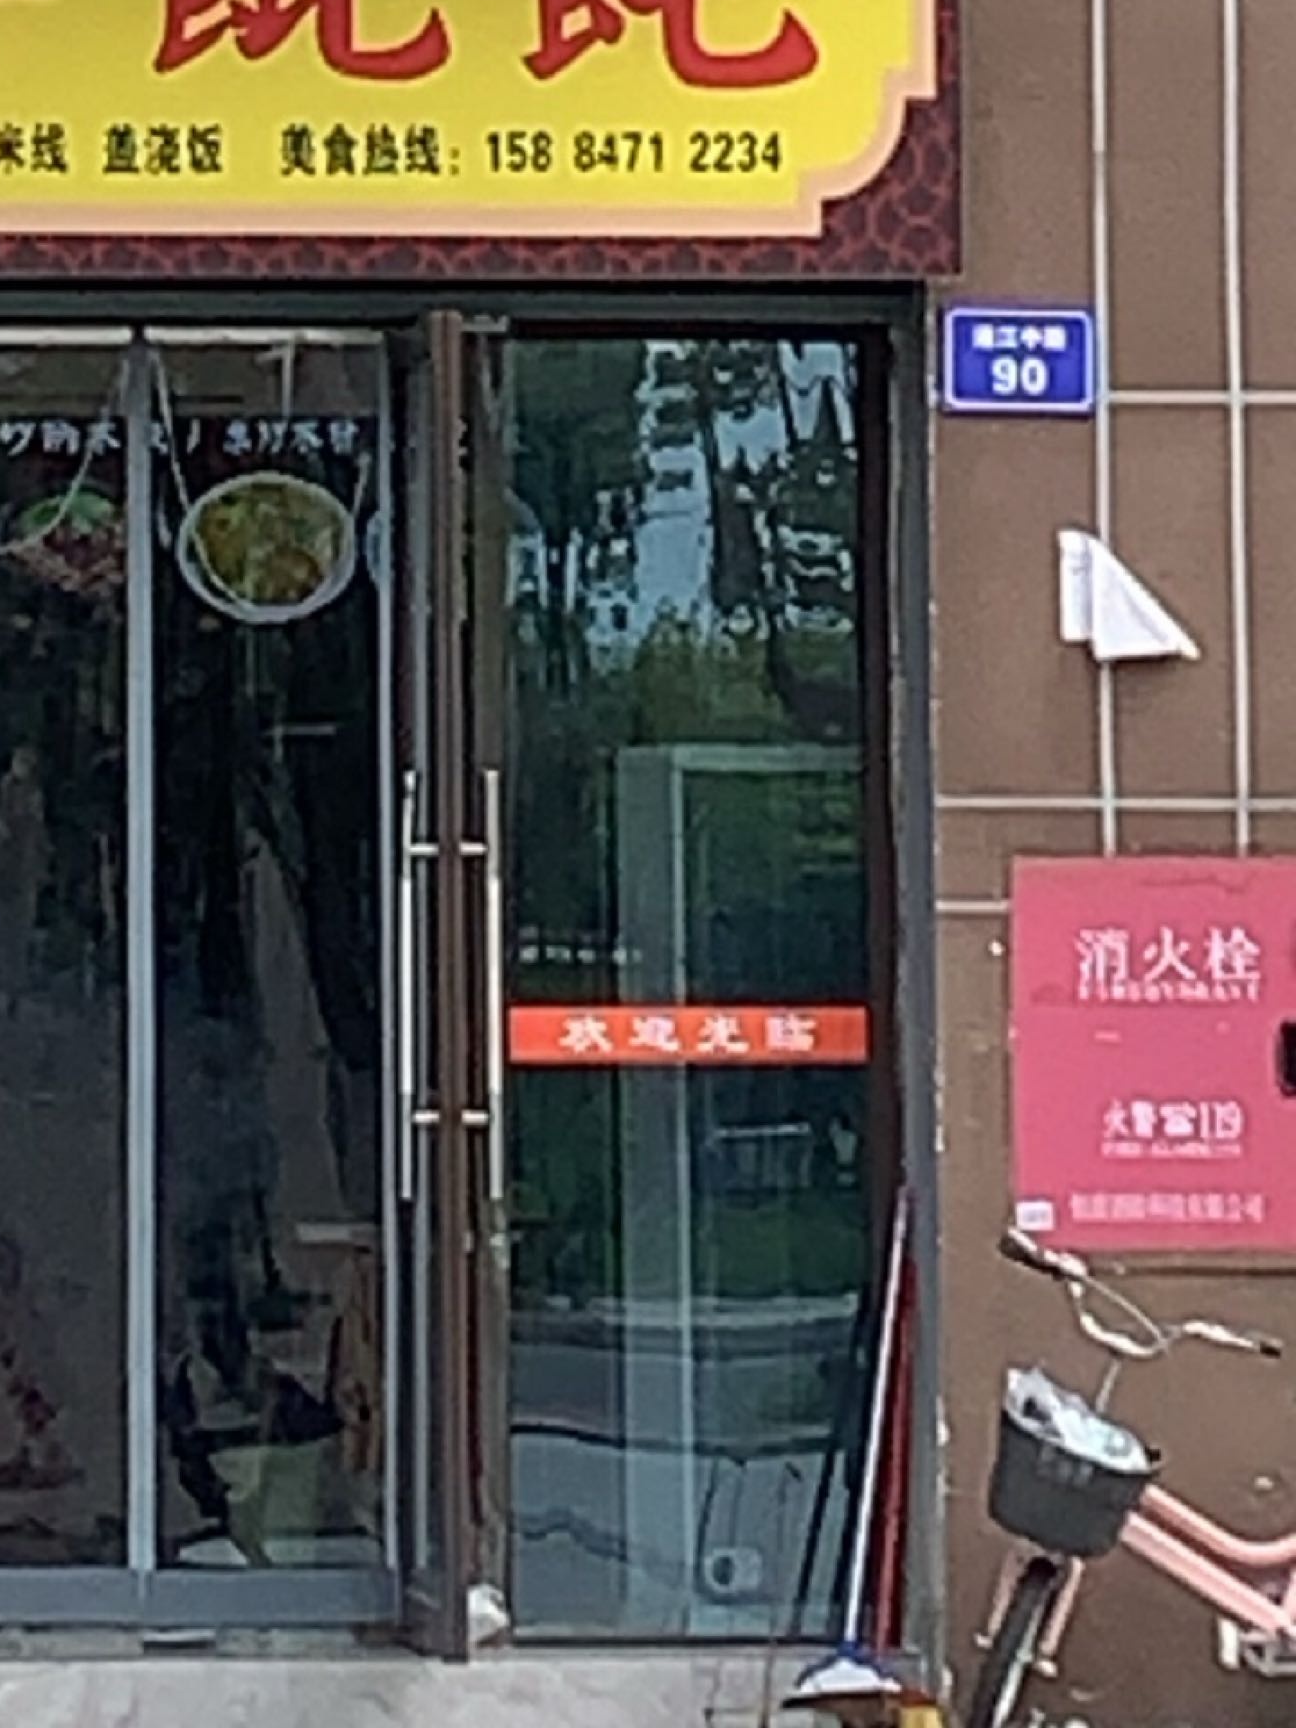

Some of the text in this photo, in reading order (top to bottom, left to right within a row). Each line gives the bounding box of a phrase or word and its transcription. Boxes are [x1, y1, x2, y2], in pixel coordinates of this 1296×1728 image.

[102, 123, 224, 175] 盖浇饭
[486, 130, 554, 174] 158
[573, 130, 664, 174] 8471
[688, 130, 783, 174] 2234
[990, 357, 1049, 396] 90
[1074, 926, 1262, 982] 消火栓
[557, 1013, 817, 1054] 欢迎光临
